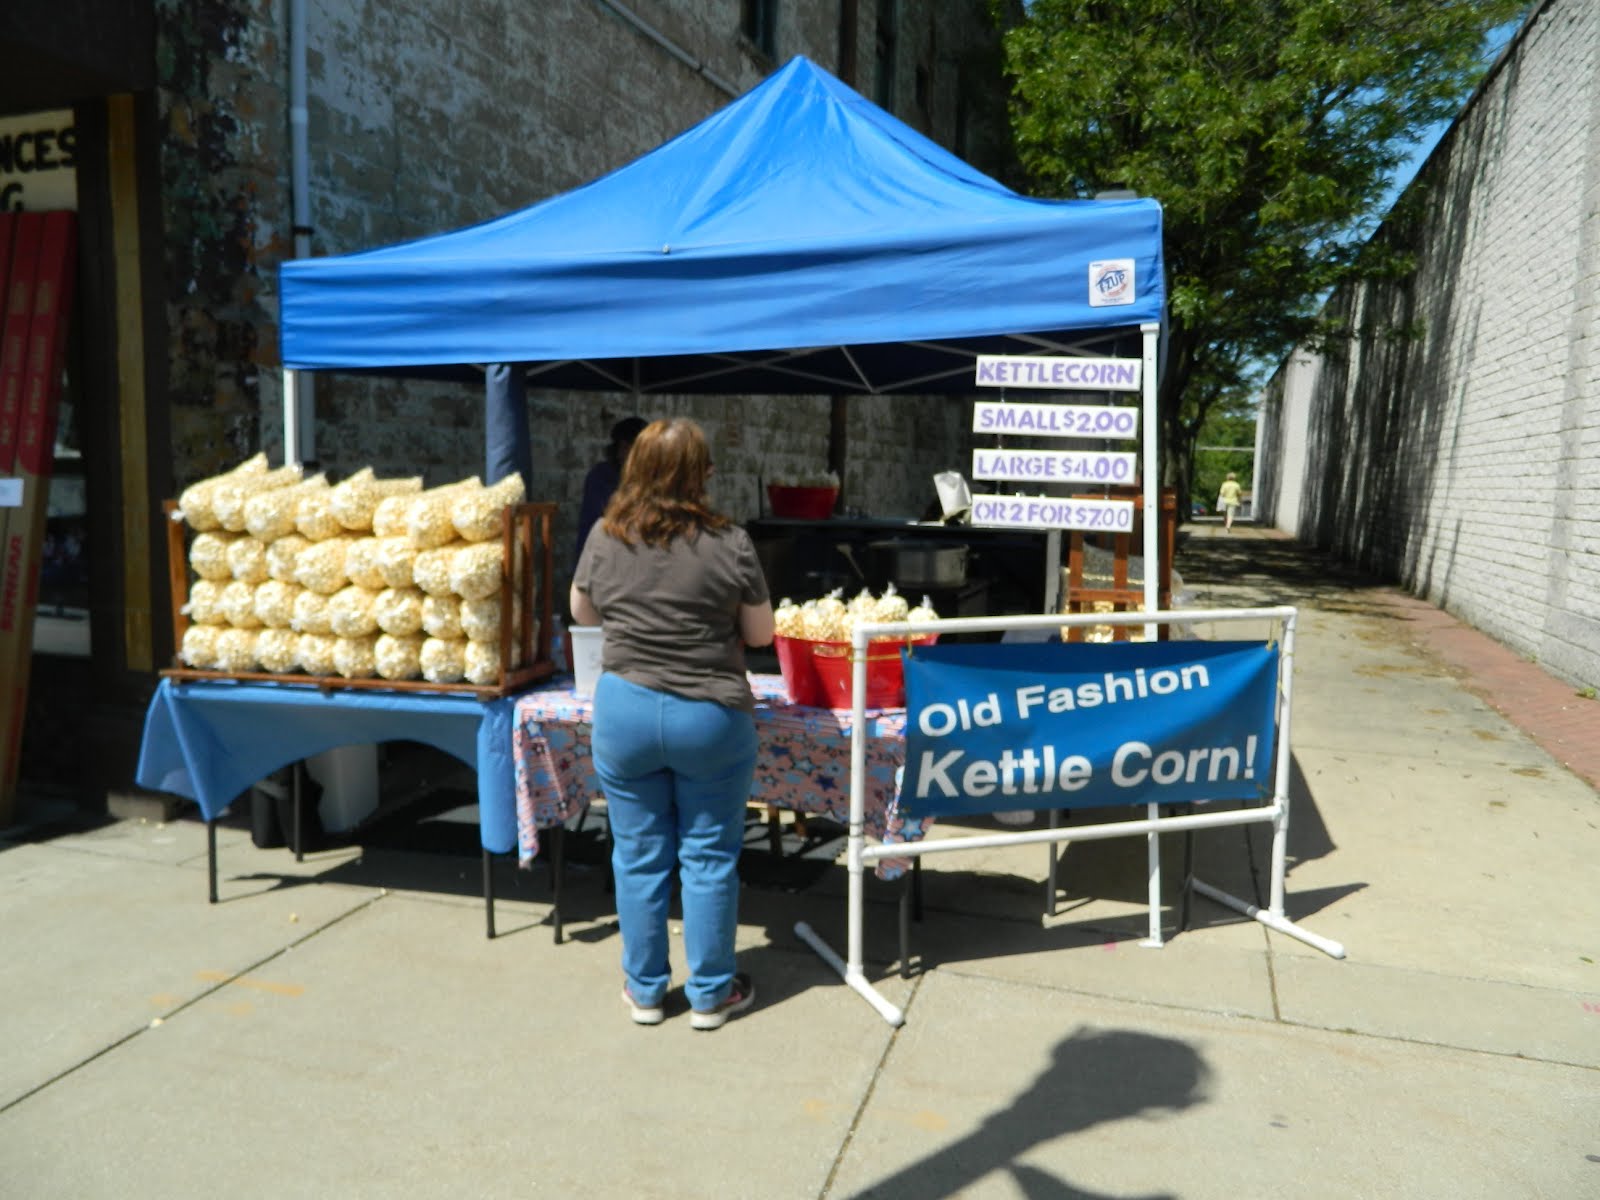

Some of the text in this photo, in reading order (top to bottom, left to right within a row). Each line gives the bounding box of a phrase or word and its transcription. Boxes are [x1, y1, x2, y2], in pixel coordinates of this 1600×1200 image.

[979, 361, 1135, 384] KETTLECORN
[980, 408, 1133, 432] SMALL $2.00
[978, 456, 1129, 479] LARGE $4.00
[974, 502, 1129, 527] OR 2 FOR $7.00
[918, 663, 1210, 737] Old Fashion
[915, 735, 1258, 798] Kettle Corn!
